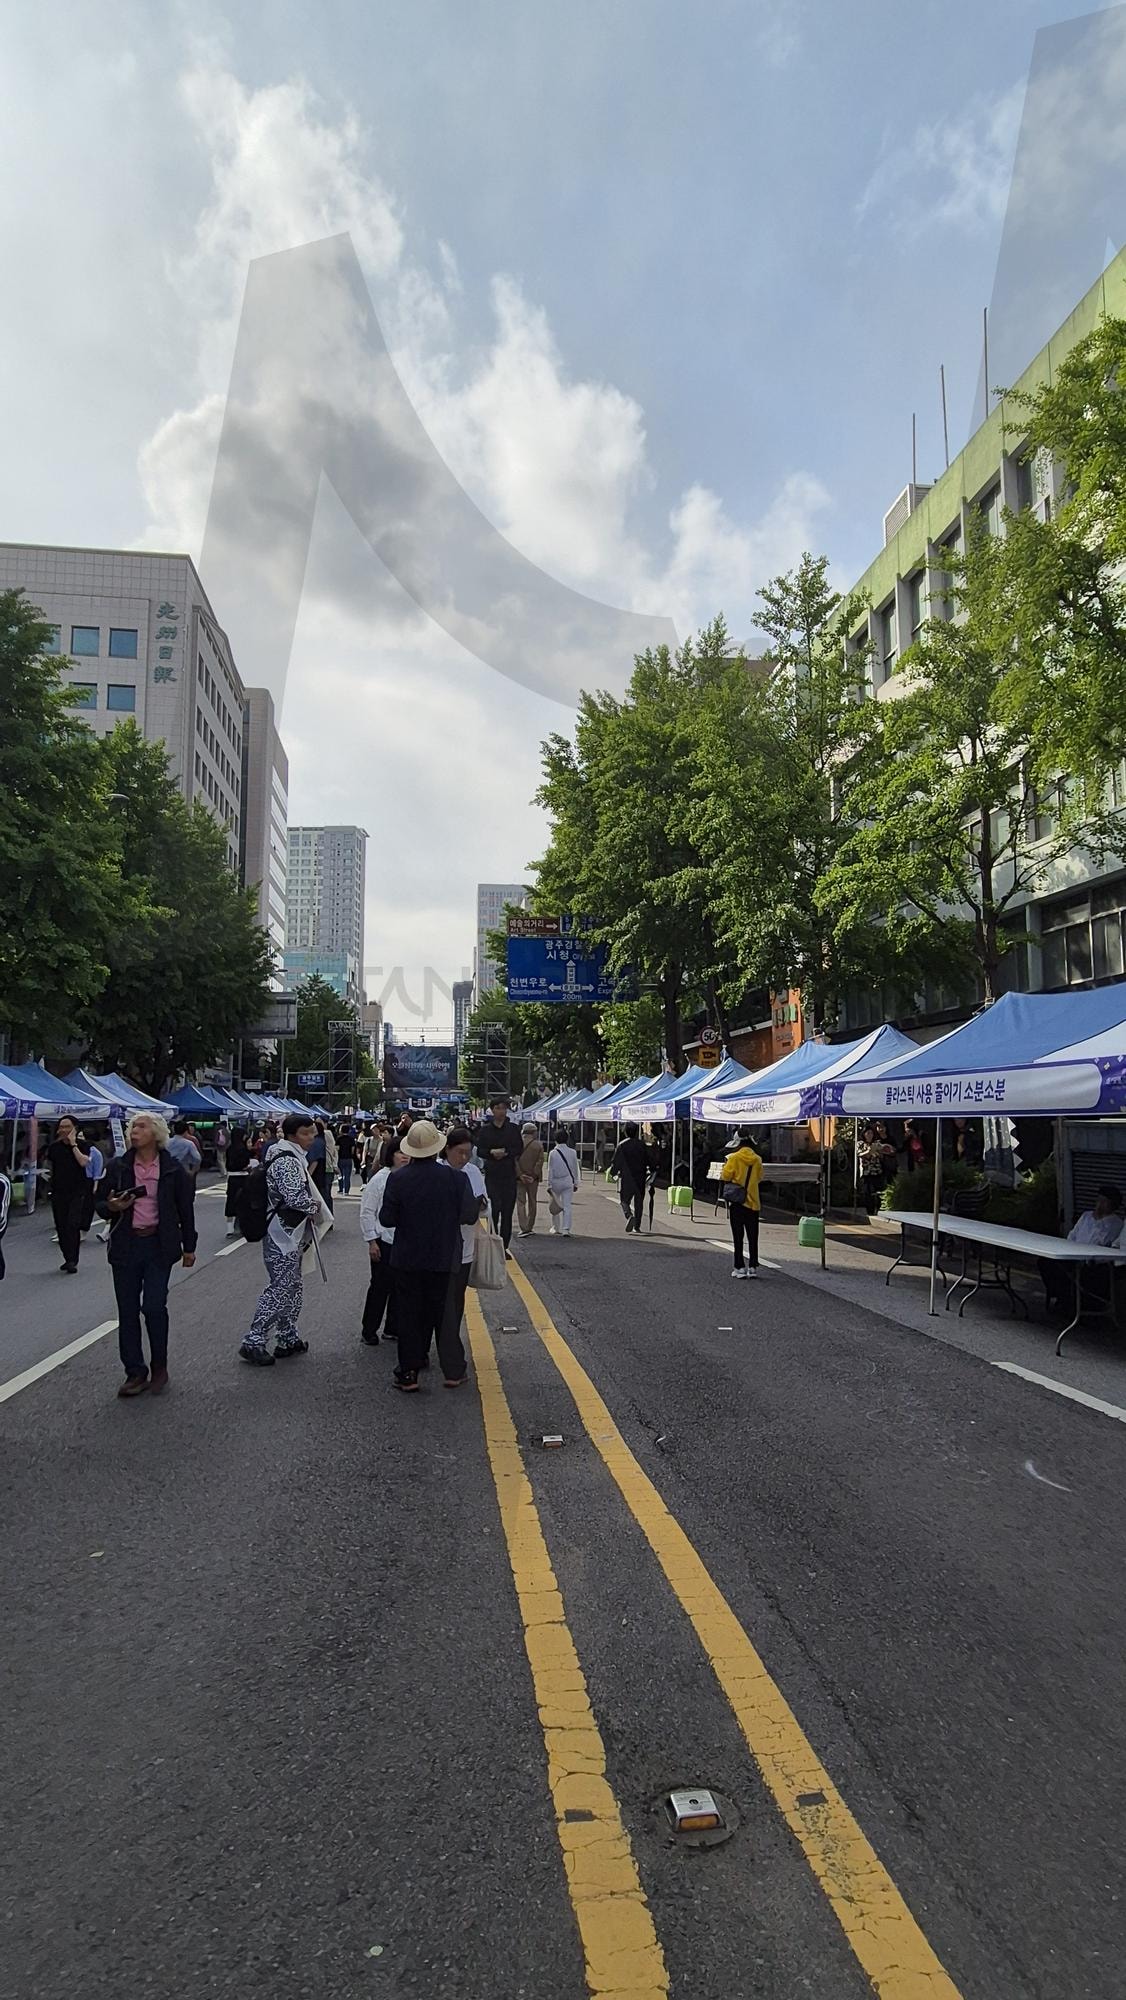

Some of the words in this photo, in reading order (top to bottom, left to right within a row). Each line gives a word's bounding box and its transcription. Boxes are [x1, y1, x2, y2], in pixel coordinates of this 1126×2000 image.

[154, 601, 180, 684] 光州日報
[509, 919, 544, 928] 예술의거리
[546, 950, 569, 960] 시청
[510, 977, 548, 988] 천변우로
[704, 1032, 715, 1041] 50
[886, 1085, 914, 1106] 플라스틱
[916, 1083, 933, 1105] 사용
[935, 1081, 962, 1103] 줄이기
[964, 1079, 1006, 1102] 소분소분
